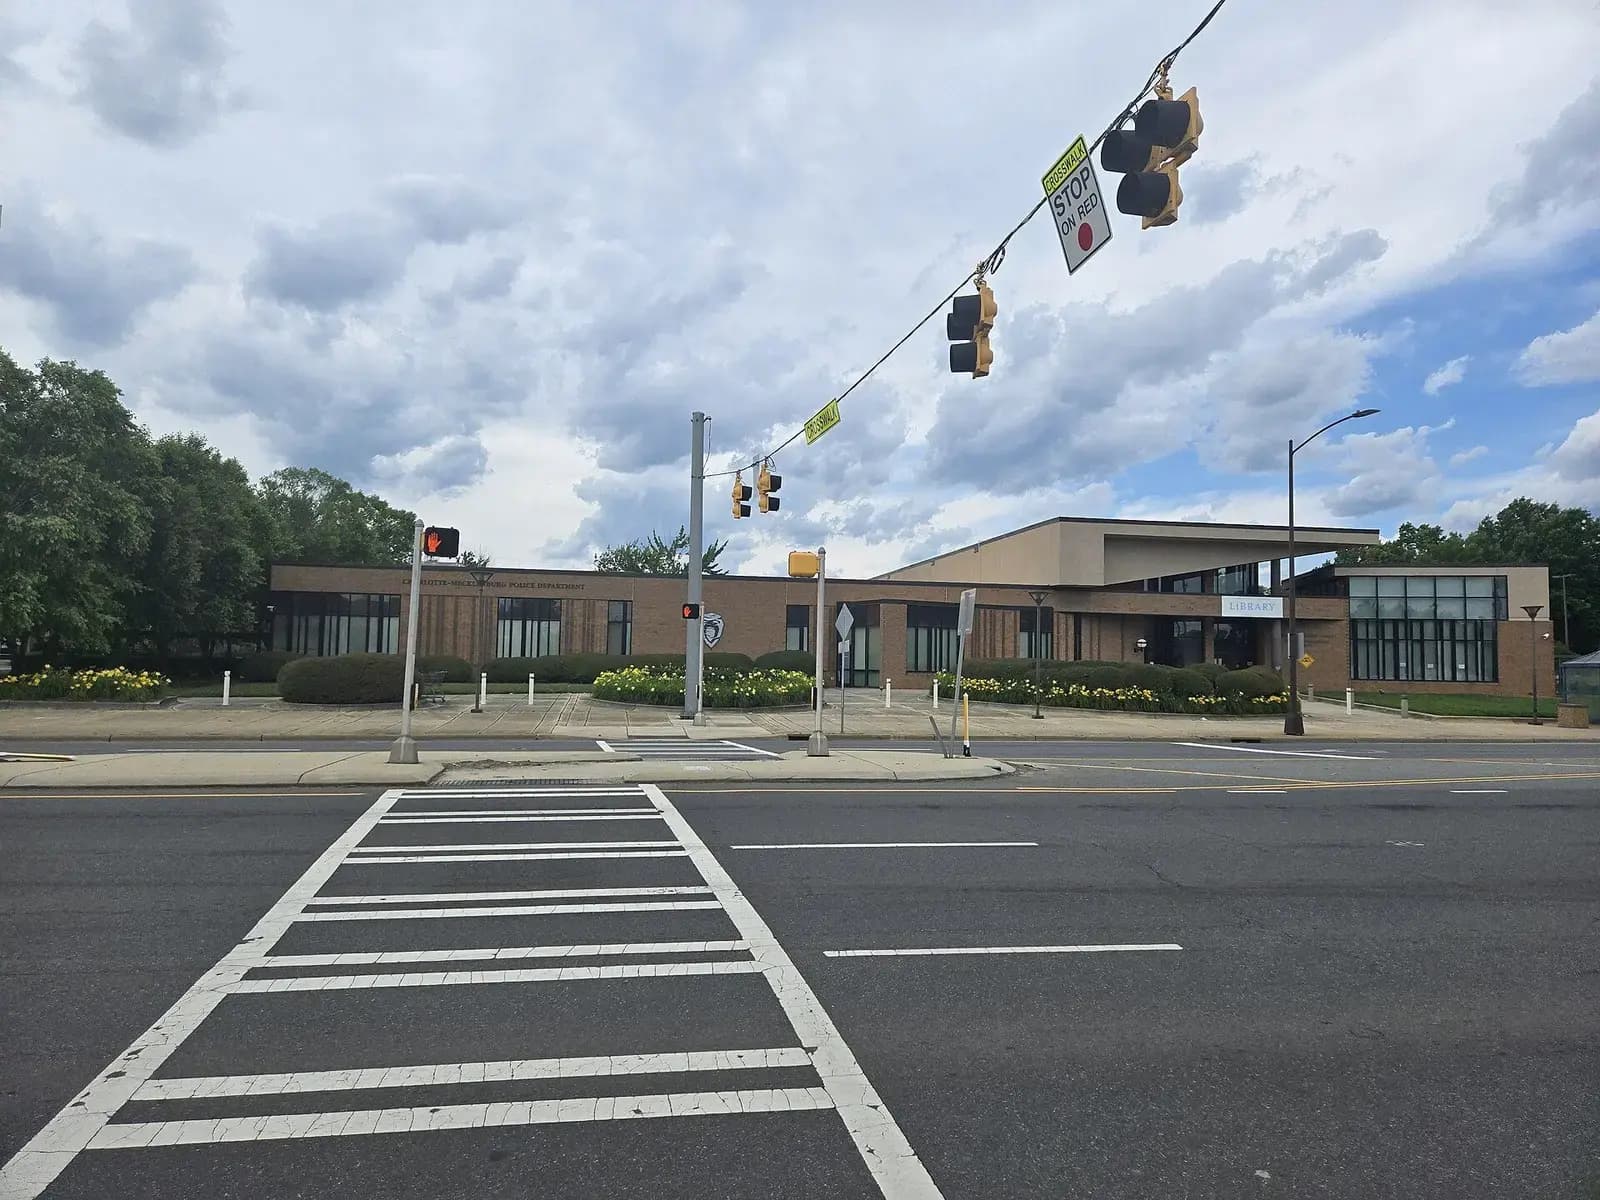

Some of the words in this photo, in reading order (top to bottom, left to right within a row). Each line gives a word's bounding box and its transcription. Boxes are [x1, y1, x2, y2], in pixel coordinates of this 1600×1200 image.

[1045, 143, 1085, 193] CROSSWALK
[1053, 166, 1090, 217] STOP
[1061, 214, 1077, 236] ON
[1077, 192, 1098, 220] RED
[807, 404, 838, 439] CROSSWALK
[537, 582, 585, 590] DEPARTMENT
[1229, 601, 1274, 611] LIBRARY
